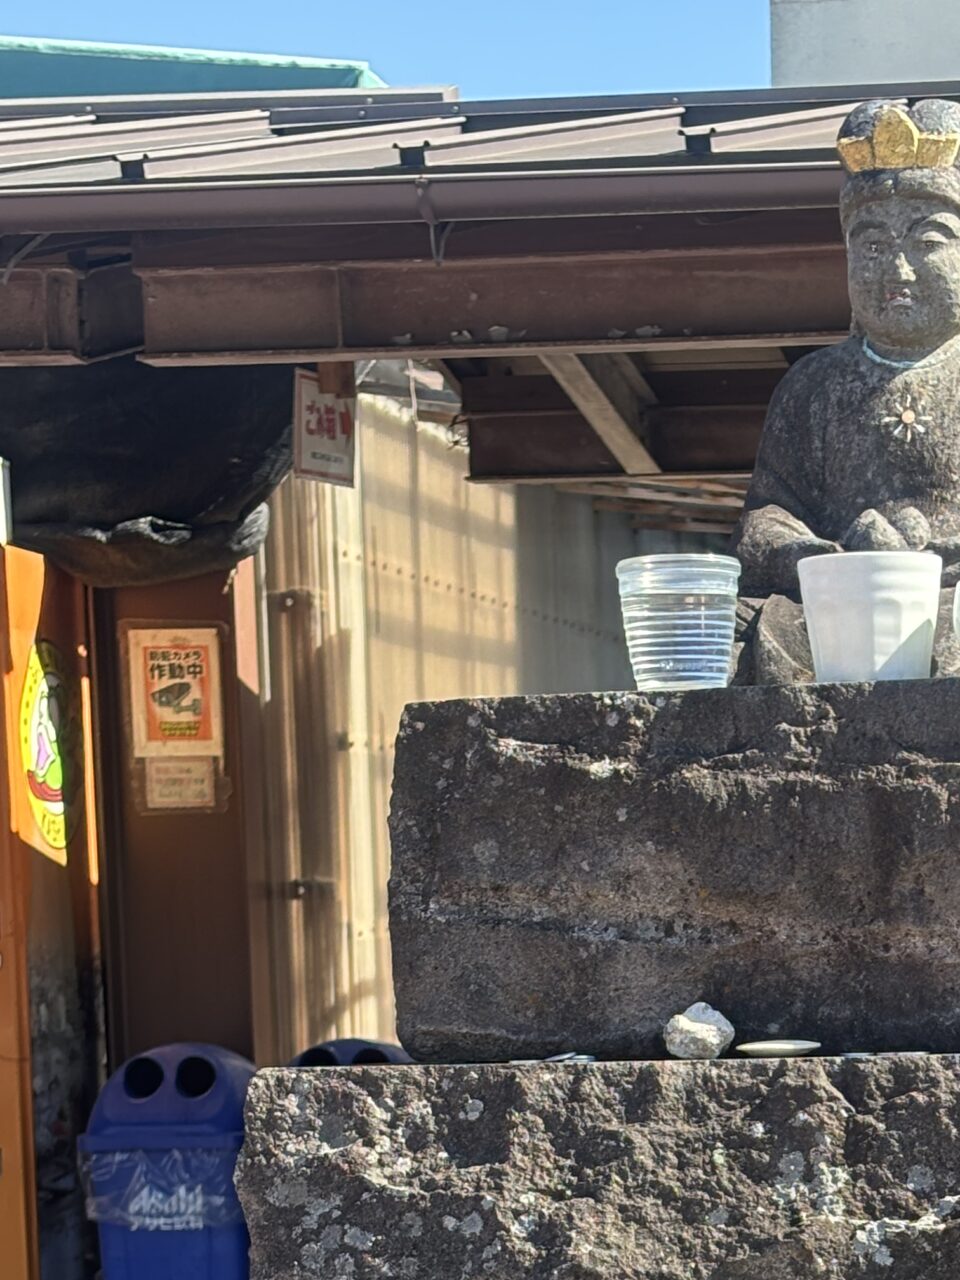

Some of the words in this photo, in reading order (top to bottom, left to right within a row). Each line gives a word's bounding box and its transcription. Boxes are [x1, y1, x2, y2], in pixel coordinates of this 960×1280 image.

[149, 662, 203, 679] 作動中
[129, 1184, 202, 1214] Asahi
